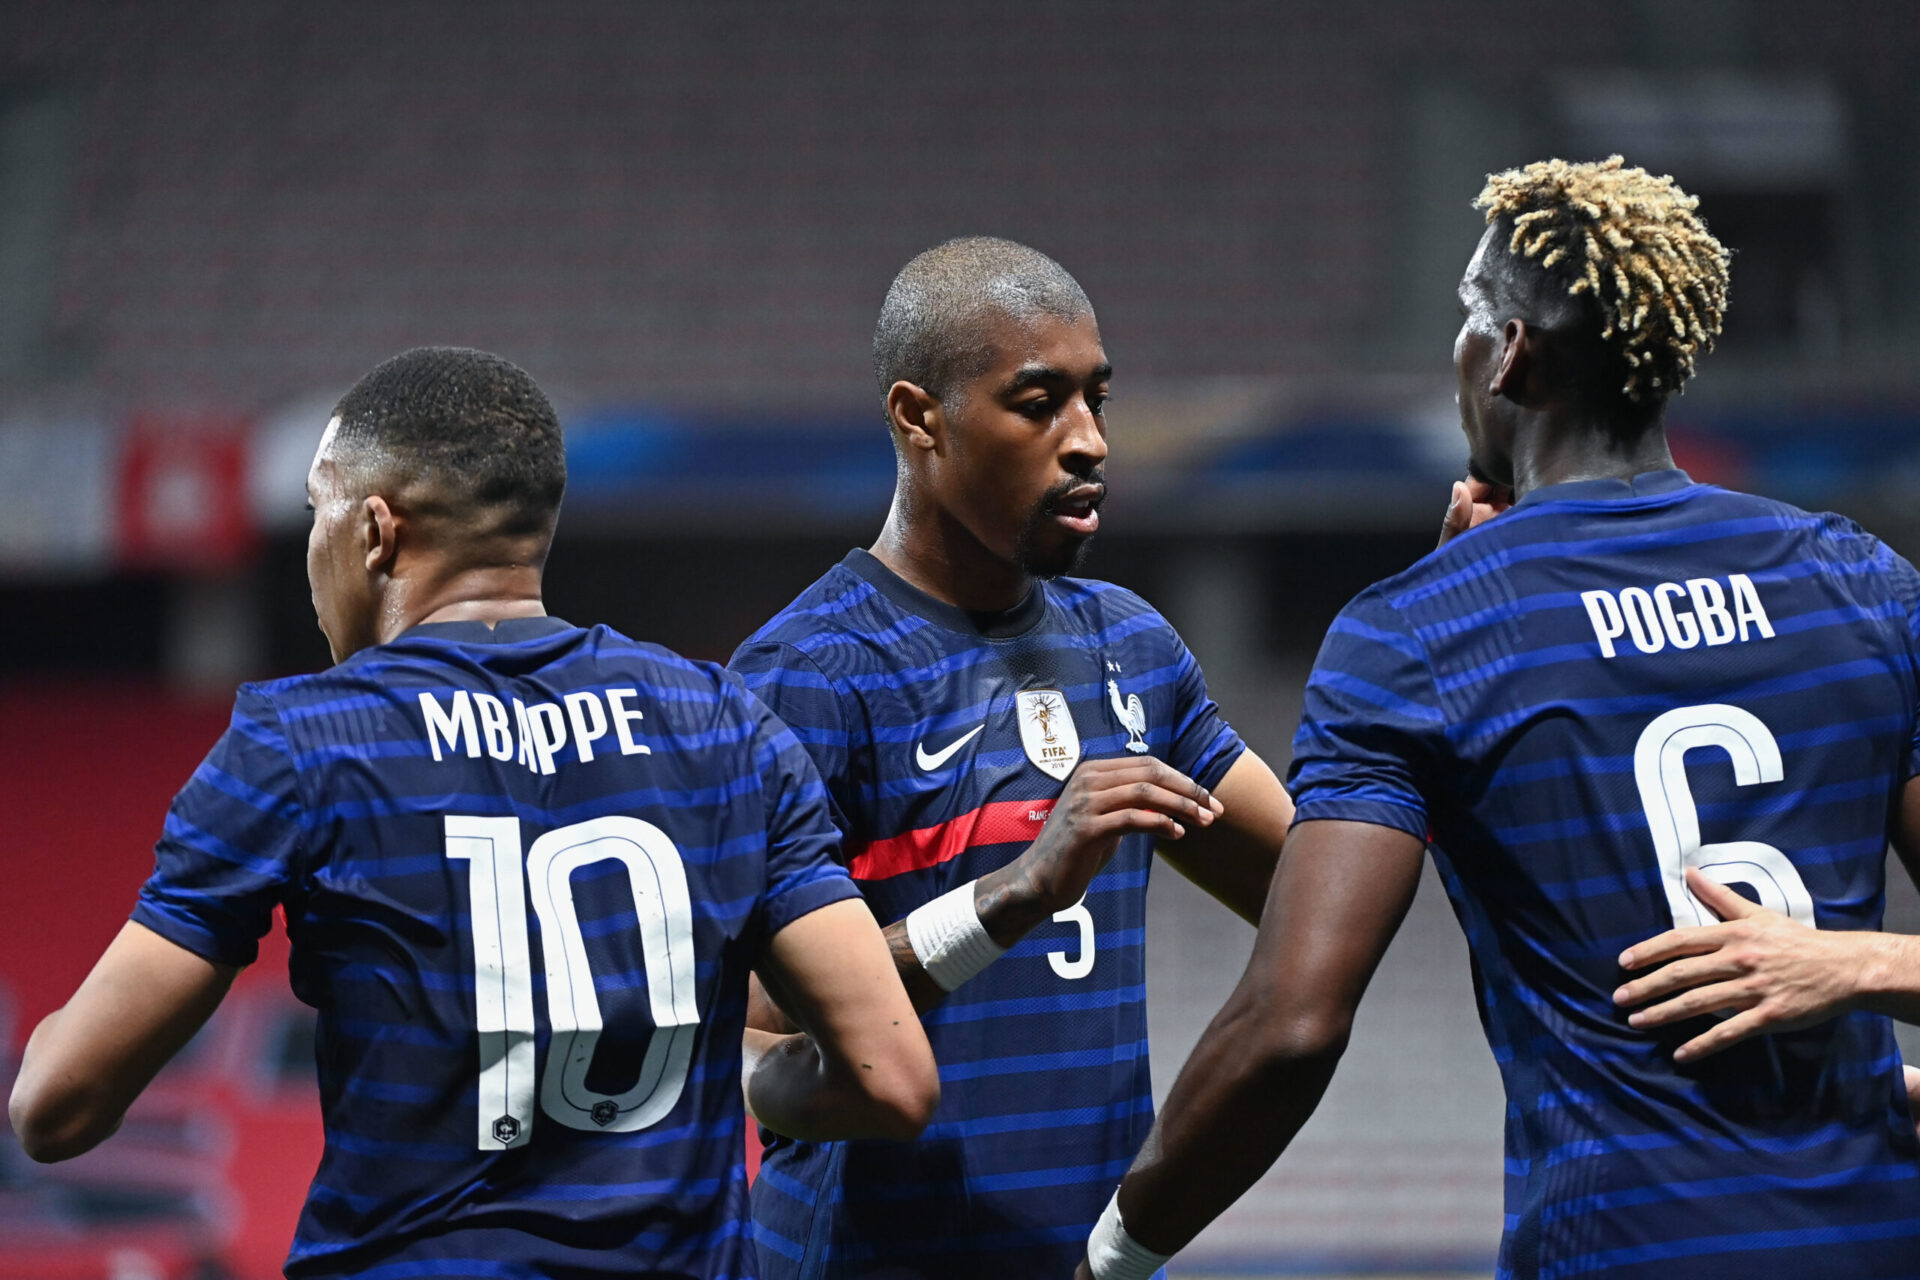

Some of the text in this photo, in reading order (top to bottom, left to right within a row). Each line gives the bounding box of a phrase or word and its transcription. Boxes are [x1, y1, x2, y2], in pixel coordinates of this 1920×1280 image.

[1581, 573, 1776, 658] POGBA
[418, 688, 651, 775] MBAPPE
[1041, 746, 1066, 758] FIFA
[1634, 703, 1816, 929] 6
[1047, 889, 1096, 980] 3
[444, 816, 700, 1150] 10
